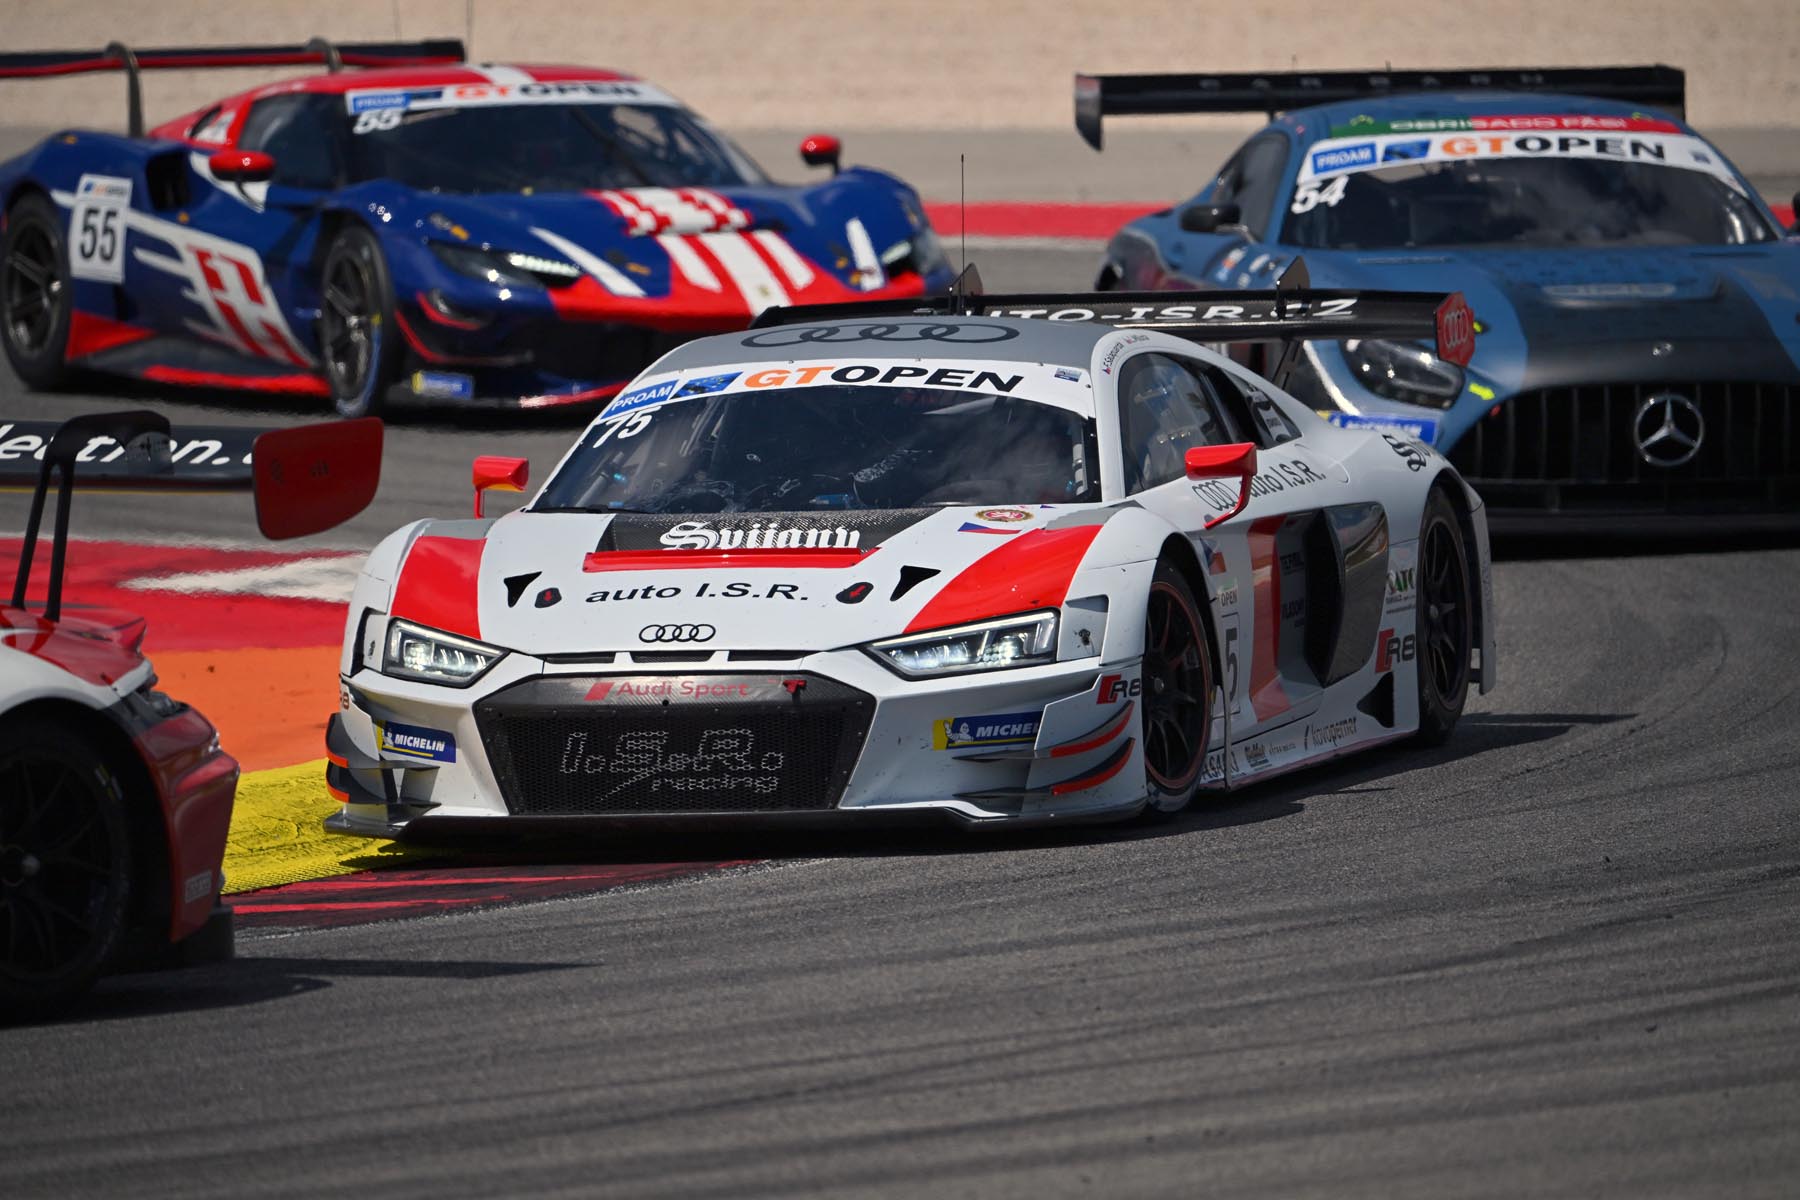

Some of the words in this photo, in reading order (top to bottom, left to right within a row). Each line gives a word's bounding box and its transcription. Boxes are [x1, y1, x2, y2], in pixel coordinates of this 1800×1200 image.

[352, 109, 402, 135] 55
[1316, 147, 1373, 169] PROAM
[1291, 173, 1349, 214] 54
[80, 207, 118, 262] 55
[611, 384, 673, 411] PROAM
[593, 405, 662, 448] 75
[585, 584, 682, 603] auto
[695, 582, 809, 601] I.S.R.
[617, 681, 673, 697] Audi
[680, 680, 749, 699] Sport
[1110, 677, 1142, 700] R8
[394, 733, 446, 752] MICHELIN
